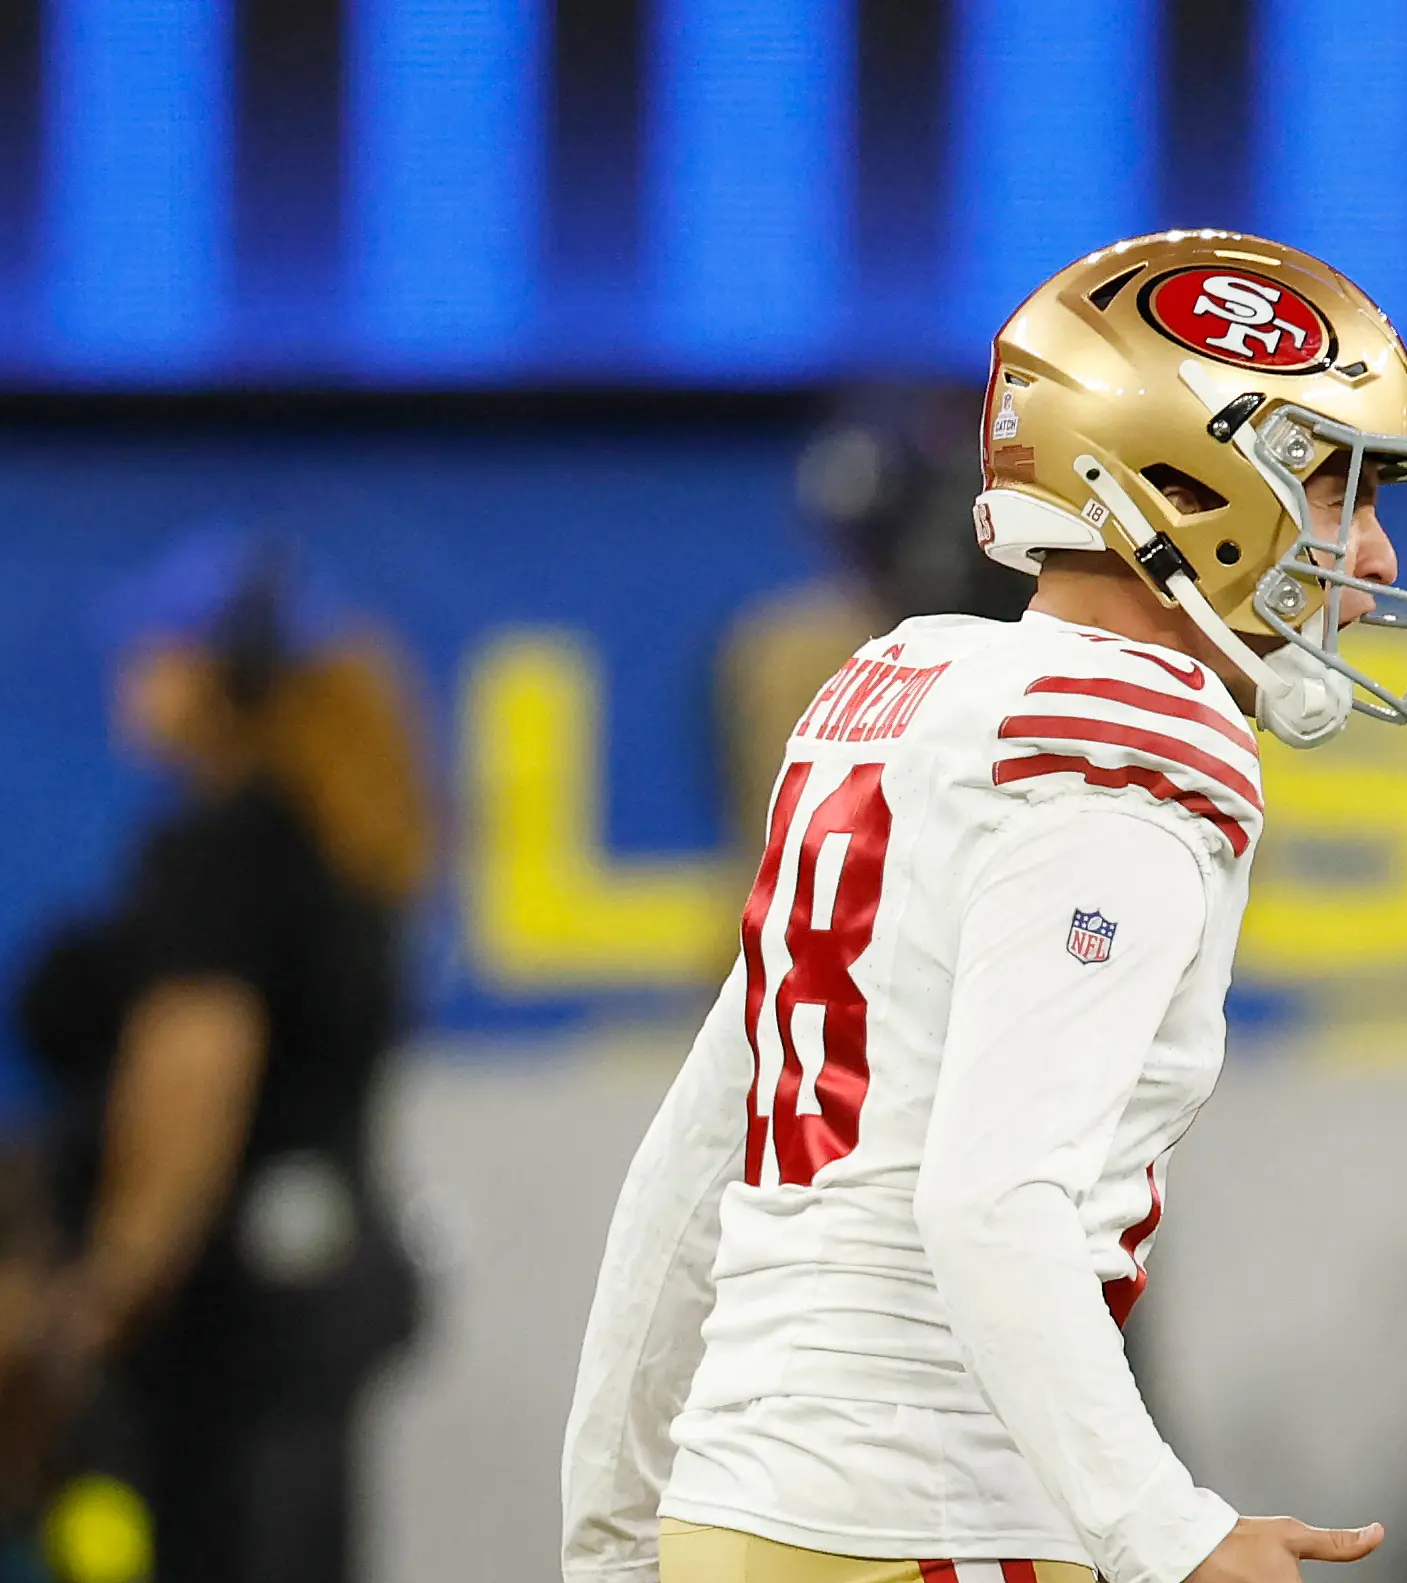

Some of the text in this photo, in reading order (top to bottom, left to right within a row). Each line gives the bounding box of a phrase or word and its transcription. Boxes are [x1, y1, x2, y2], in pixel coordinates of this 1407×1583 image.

[1193, 274, 1306, 360] SF
[1085, 502, 1104, 523] 18
[742, 761, 893, 1188] 18
[1071, 929, 1105, 961] NFL
